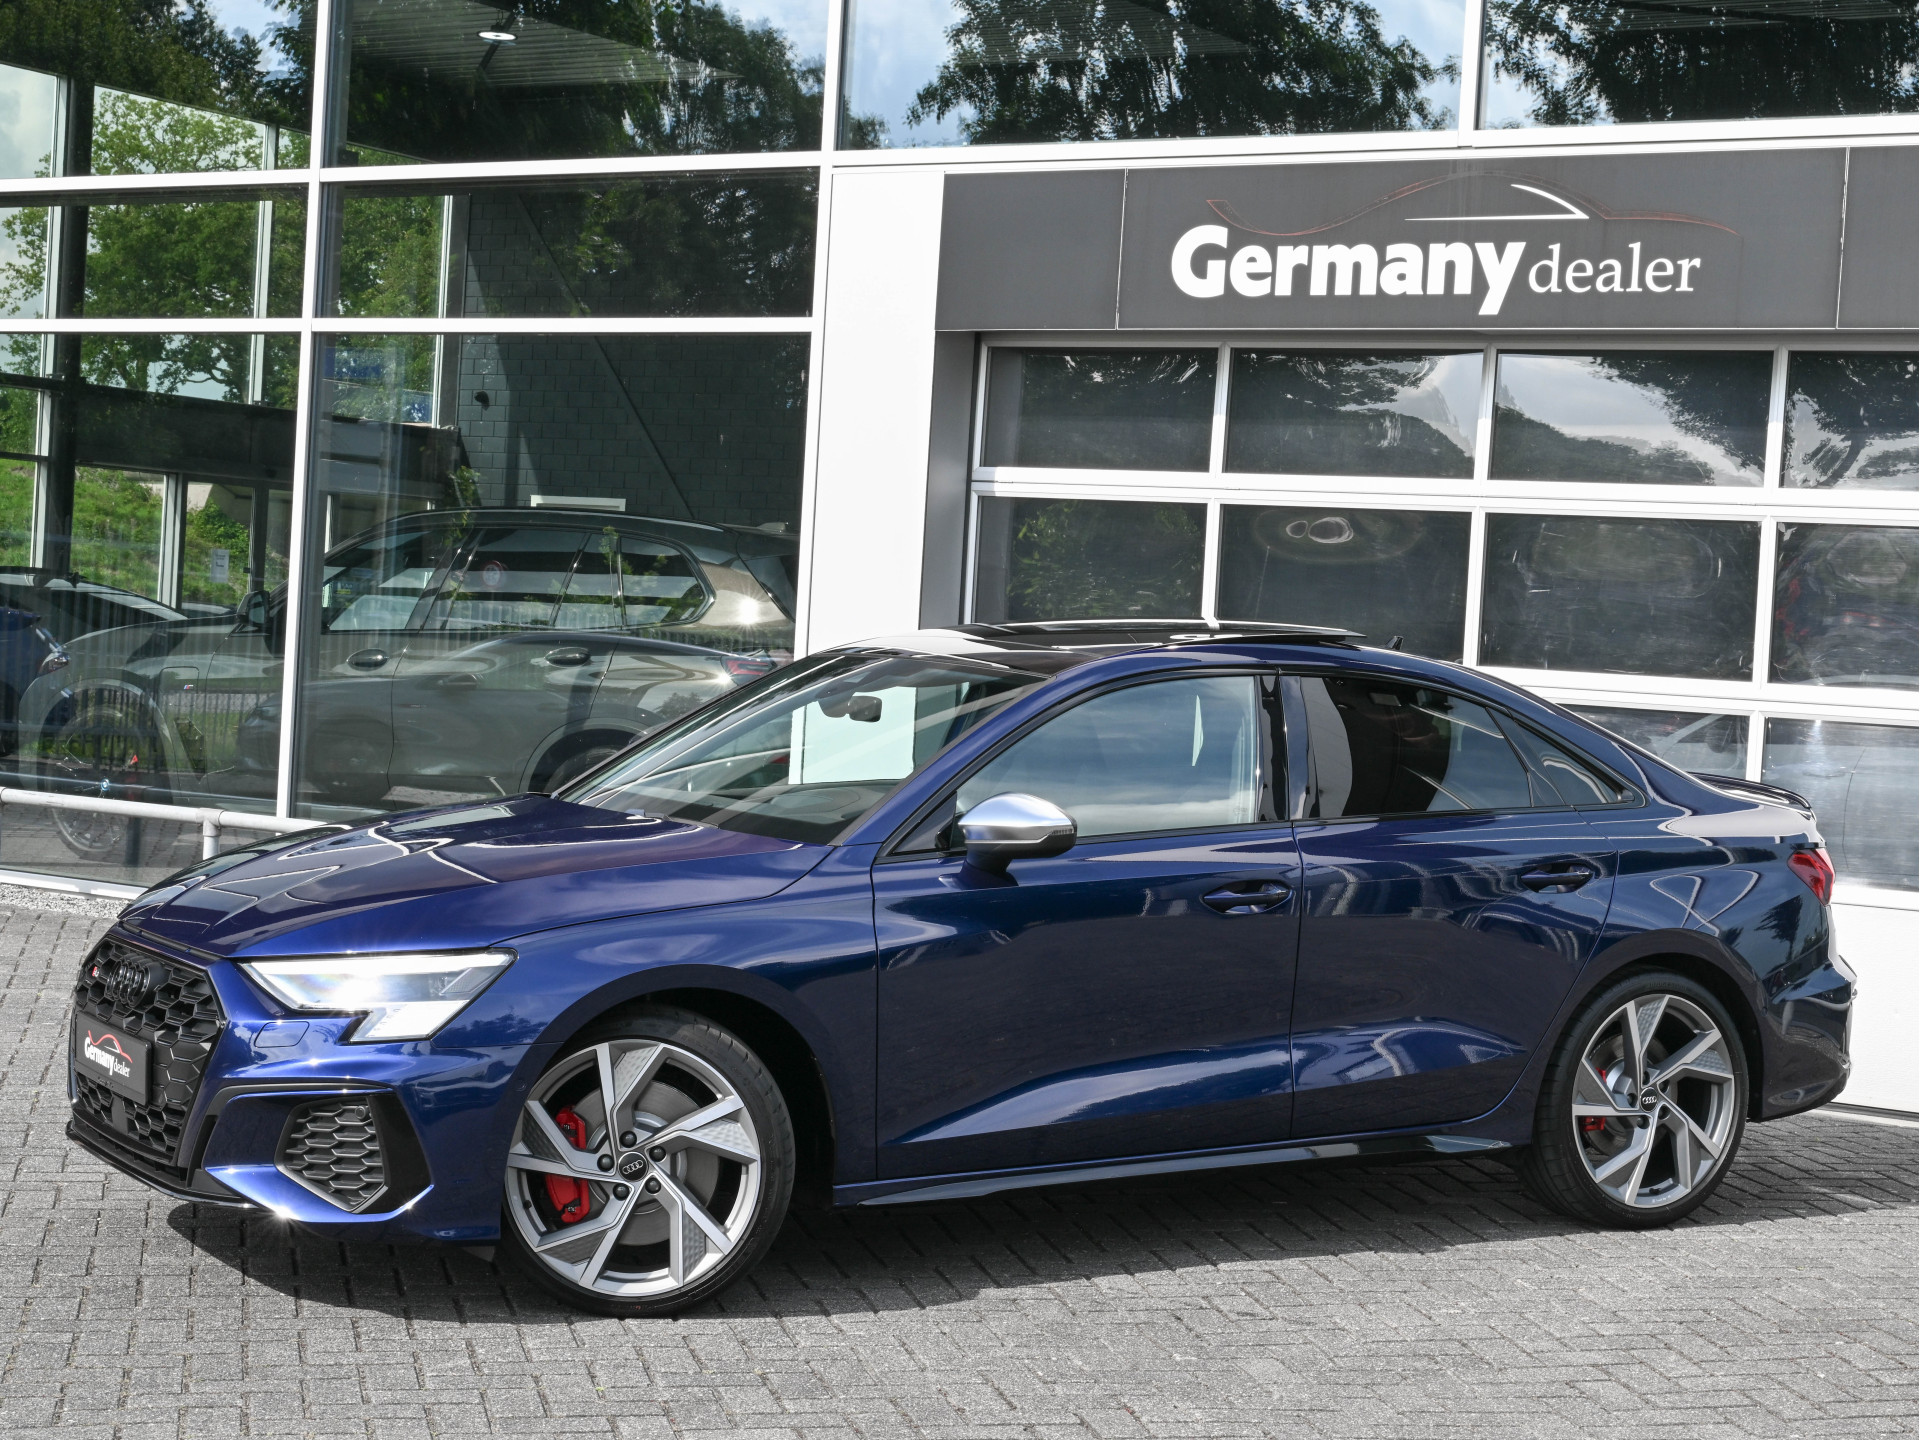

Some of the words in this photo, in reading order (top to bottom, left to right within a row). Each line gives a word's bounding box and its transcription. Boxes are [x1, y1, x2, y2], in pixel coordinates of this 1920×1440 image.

[1170, 224, 1527, 316] Germany
[1528, 241, 1702, 294] dealer
[84, 1036, 115, 1076] Germany
[113, 1058, 131, 1077] dealer
